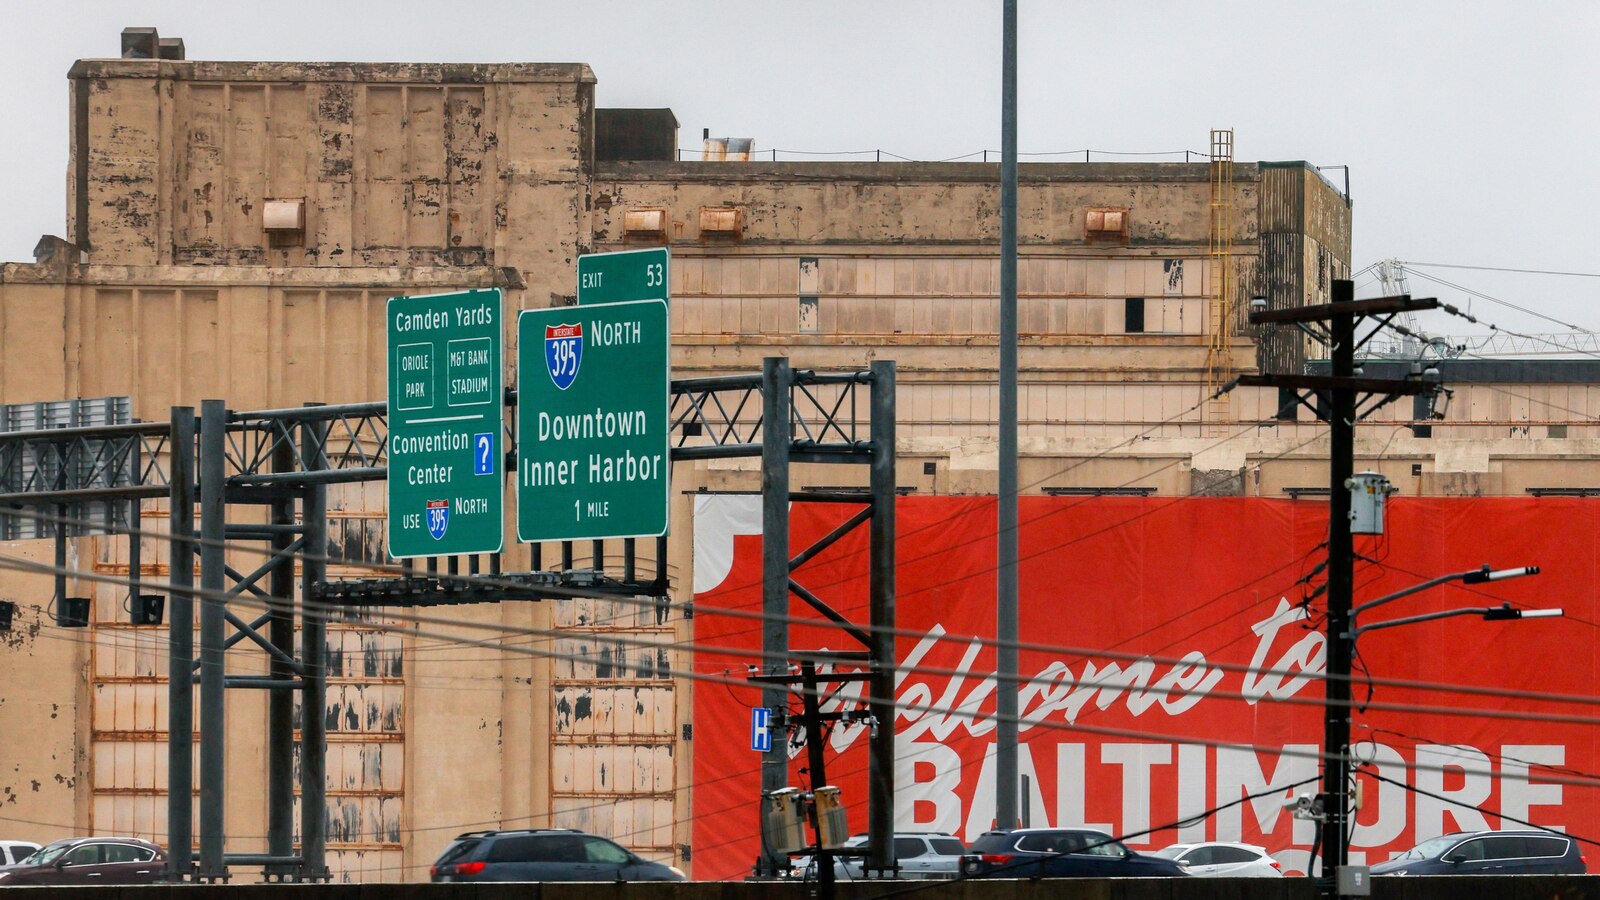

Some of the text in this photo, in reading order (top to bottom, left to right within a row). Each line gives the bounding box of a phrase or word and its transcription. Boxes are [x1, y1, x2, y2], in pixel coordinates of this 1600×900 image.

[582, 263, 662, 288] EXIT 53
[396, 304, 492, 332] Camden Yards
[402, 354, 428, 371] ORIOLE
[450, 350, 488, 367] M&T BANK
[552, 340, 576, 377] 395
[406, 382, 424, 398] PARK
[452, 377, 488, 395] STADIUM
[538, 408, 646, 442] Downtown
[392, 429, 468, 455] Convention
[408, 463, 453, 486] Center
[524, 449, 661, 486] Inner Harbor
[403, 514, 420, 529] USE
[430, 509, 446, 531] 395
[574, 500, 609, 522] 1 MILE
[1241, 596, 1327, 705] to
[754, 710, 768, 749] H
[893, 741, 1566, 848] BALTIMORE
